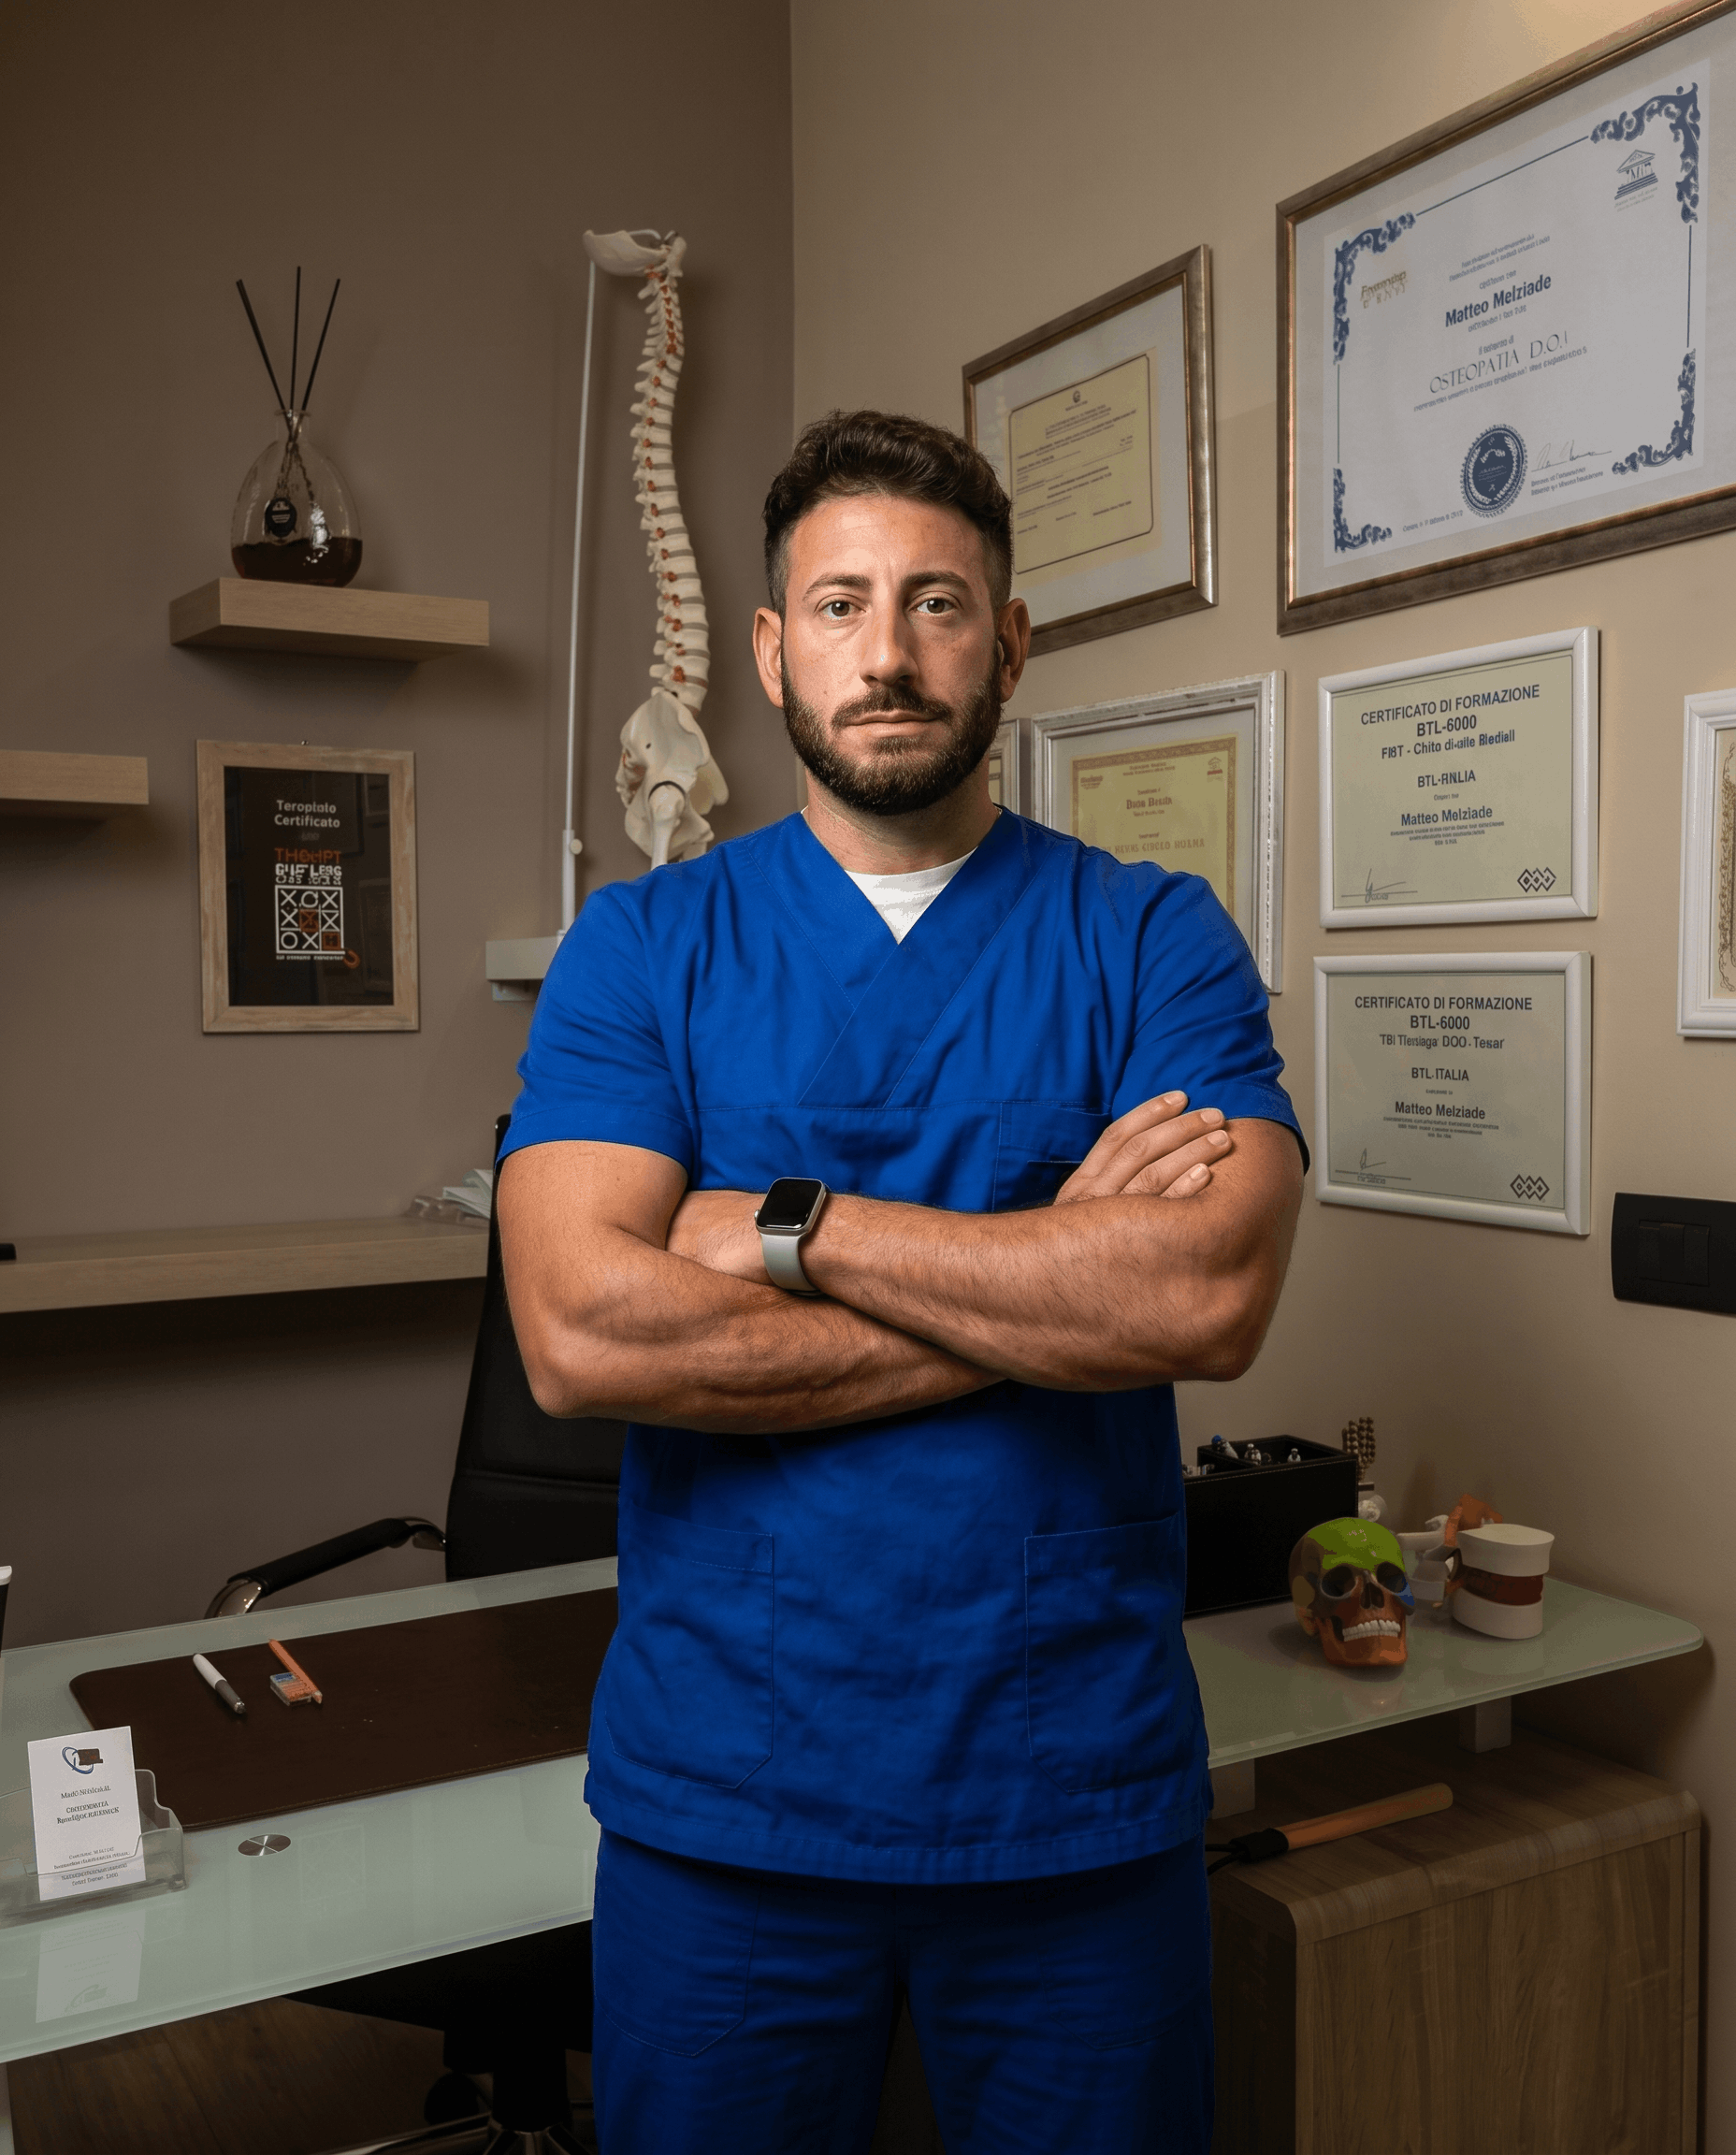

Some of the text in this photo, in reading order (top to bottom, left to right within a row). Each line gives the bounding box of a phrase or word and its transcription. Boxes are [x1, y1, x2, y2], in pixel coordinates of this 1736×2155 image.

[1445, 299, 1489, 327] Matteo
[1493, 274, 1552, 310] Melziade
[1429, 349, 1520, 394] OSTEOPATIA
[1361, 684, 1541, 725] CERTIFICATO DI FORMAZIONE
[1416, 714, 1477, 737] BTL-6000
[273, 814, 340, 829] Certificato
[1401, 814, 1439, 827] Matteo
[1354, 996, 1533, 1011] CERTIFICATO DI FORMAZIONE
[1410, 1015, 1470, 1030] BTL-6000
[1395, 1101, 1486, 1120] Matteo Melziade
